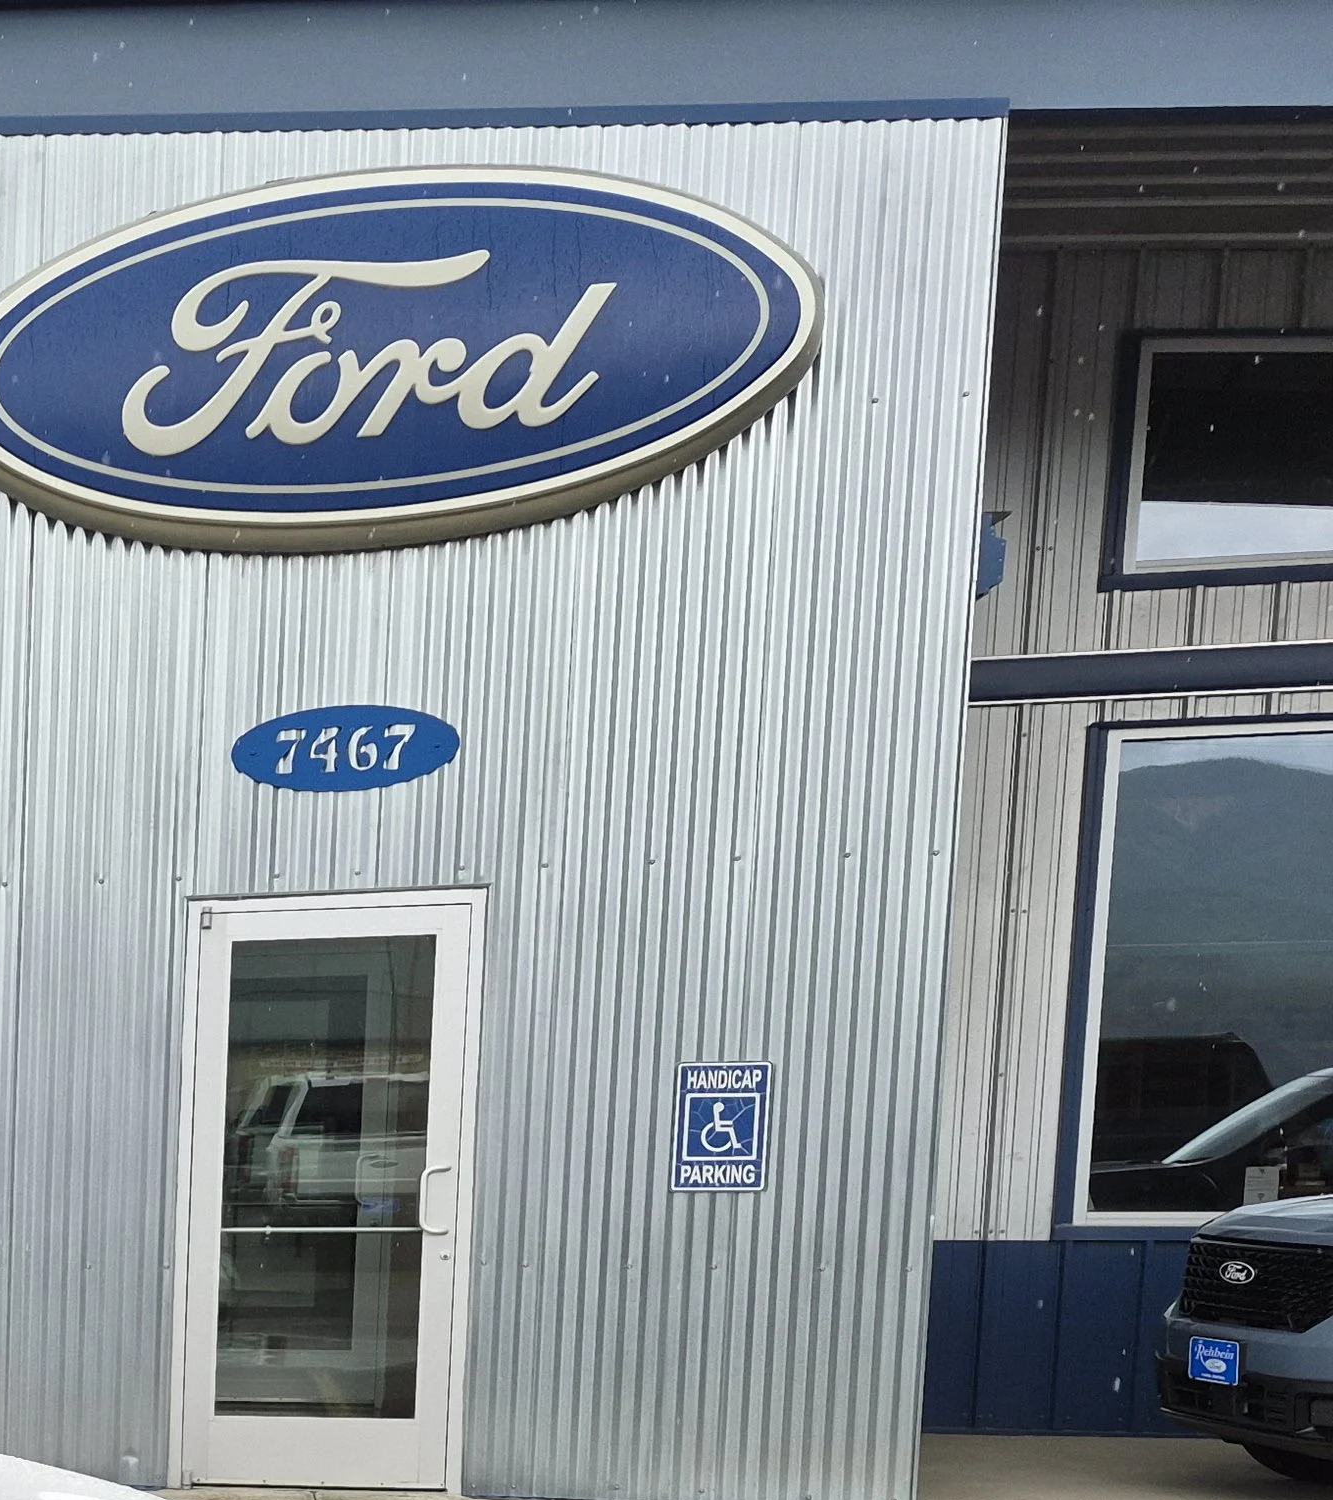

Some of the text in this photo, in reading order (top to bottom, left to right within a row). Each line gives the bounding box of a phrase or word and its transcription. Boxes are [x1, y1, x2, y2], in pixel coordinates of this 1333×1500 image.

[121, 249, 618, 457] Ford
[275, 723, 417, 775] 7467
[686, 1068, 763, 1090] HANDICAP
[679, 1164, 756, 1185] PARKING
[1225, 1264, 1247, 1280] Ford
[1195, 1343, 1234, 1360] Rehbein
